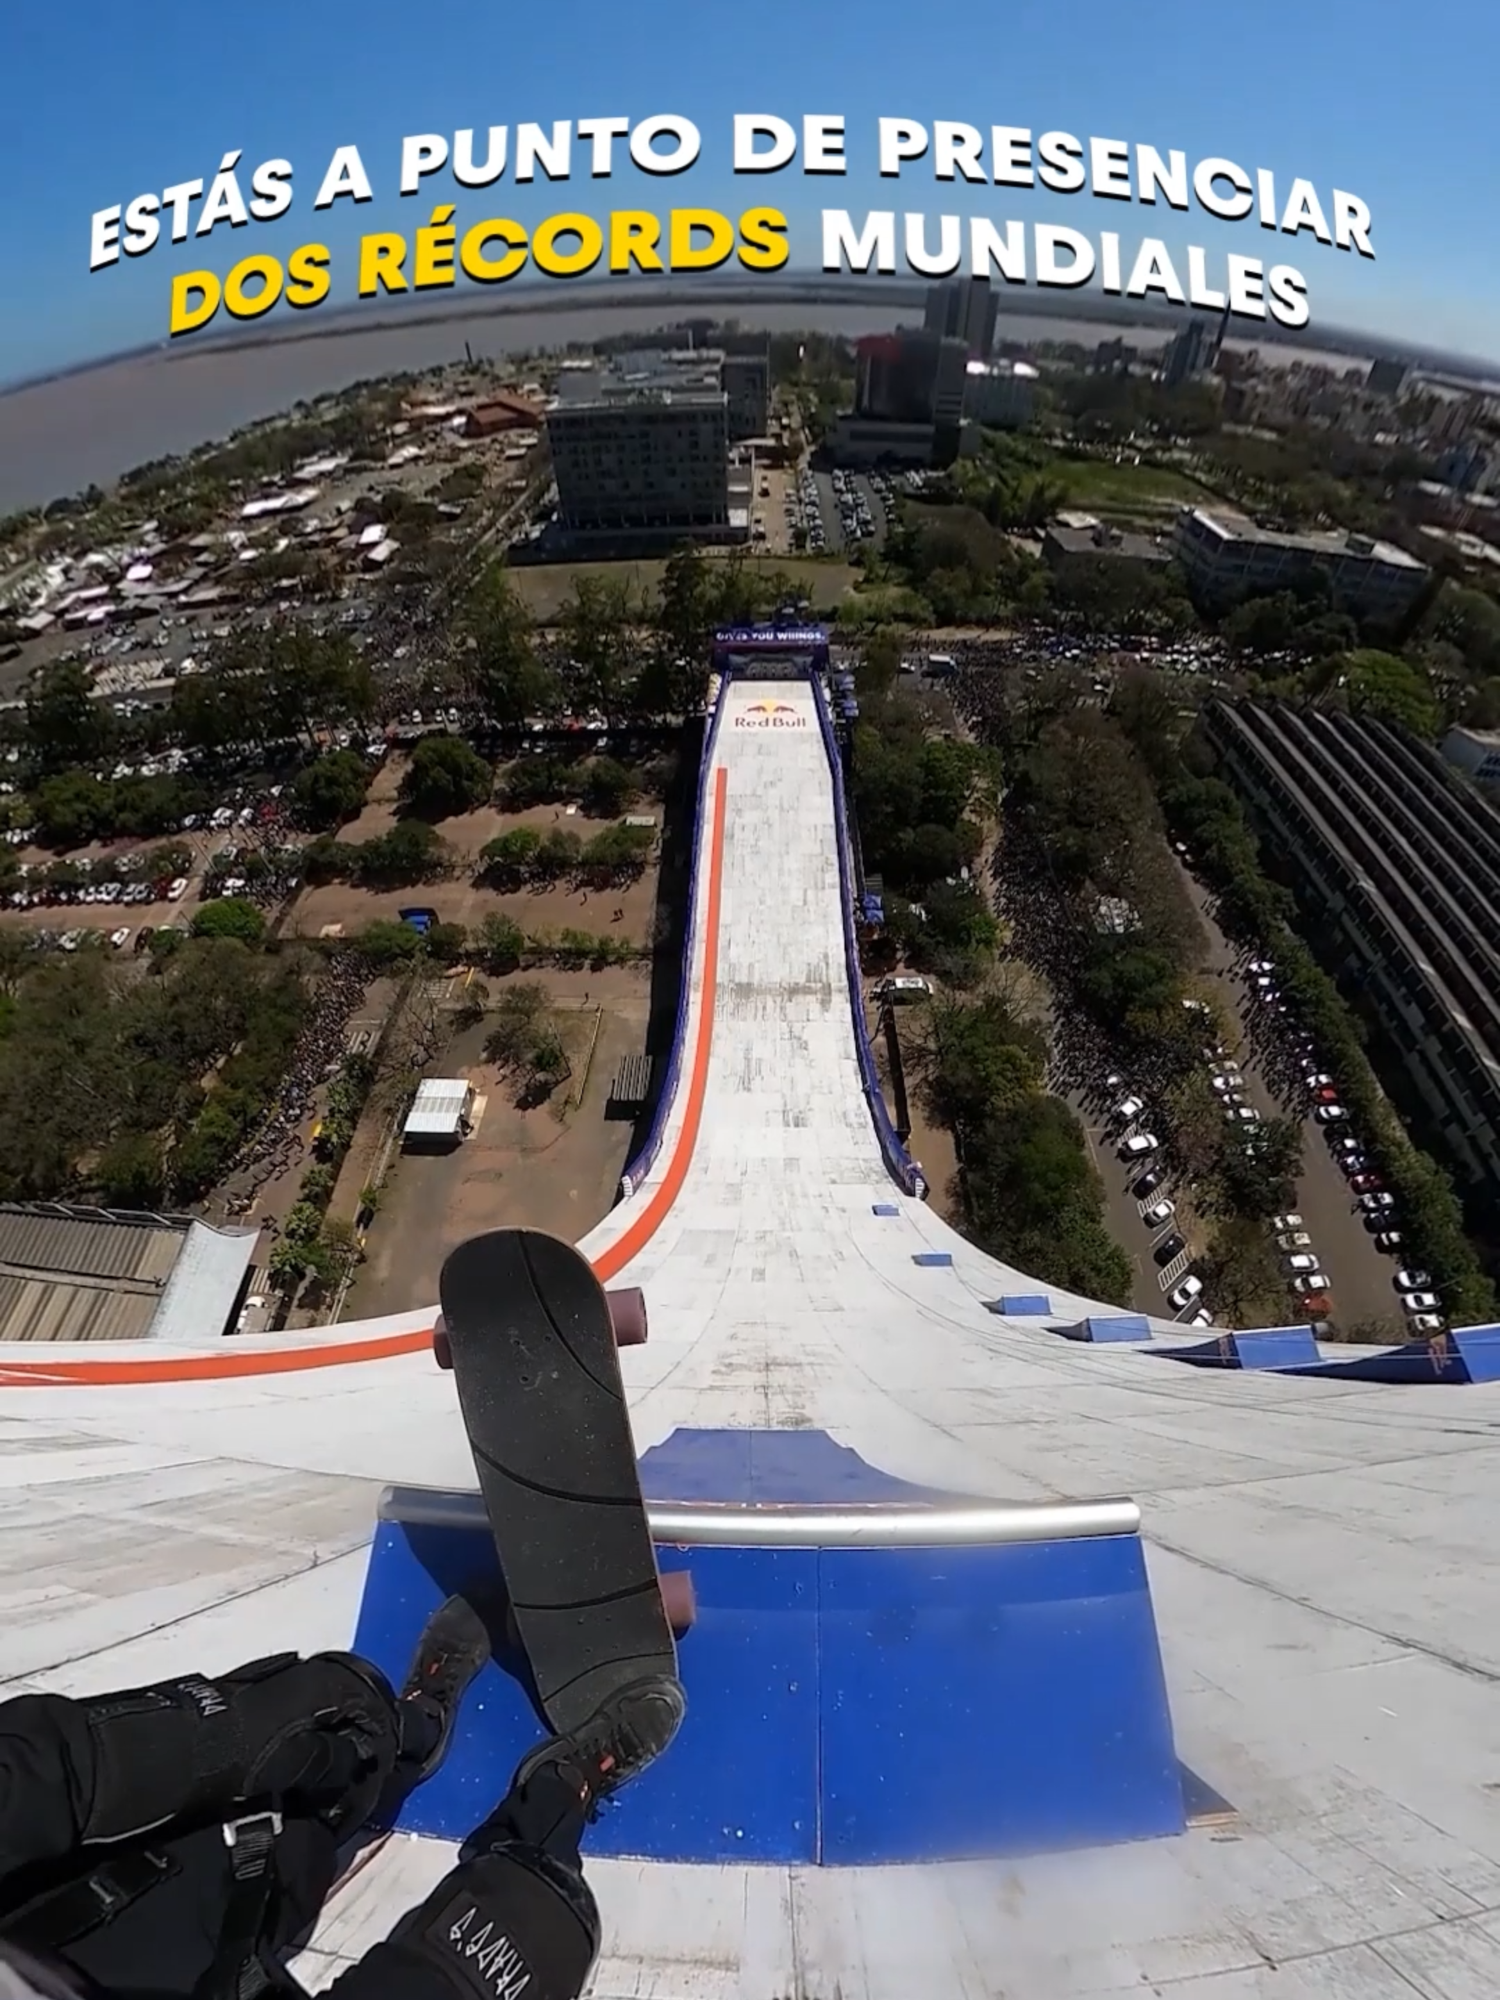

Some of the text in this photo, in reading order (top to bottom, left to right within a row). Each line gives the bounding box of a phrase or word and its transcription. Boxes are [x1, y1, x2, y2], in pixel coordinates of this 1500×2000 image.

[751, 632, 774, 641] YOU
[735, 717, 807, 728] Red Bull
